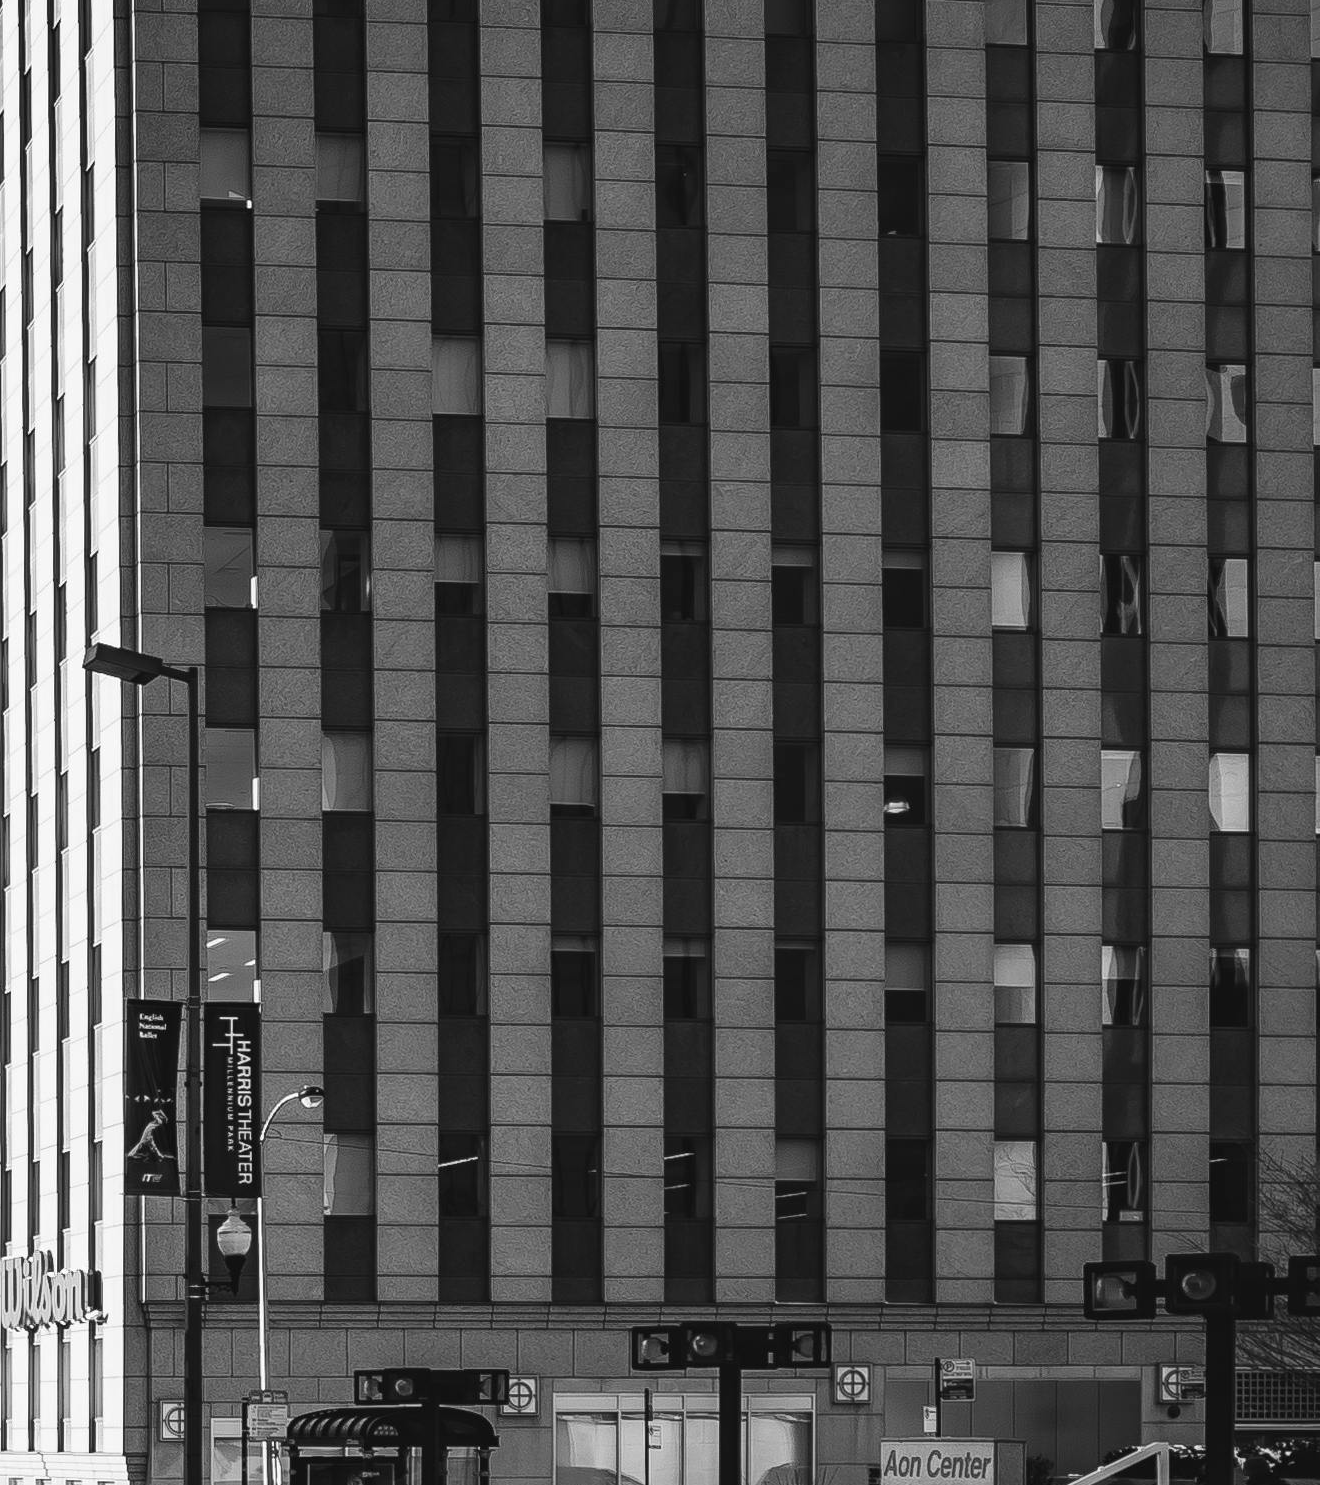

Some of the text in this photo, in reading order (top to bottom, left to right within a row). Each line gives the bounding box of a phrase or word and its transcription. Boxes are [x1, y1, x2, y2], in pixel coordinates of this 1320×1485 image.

[226, 1056, 235, 1152] MILLENNIUM PARK
[236, 1040, 254, 1185] HARRIS THEATER
[0, 1250, 84, 1331] Wilson
[883, 1449, 992, 1479] Aon Center
